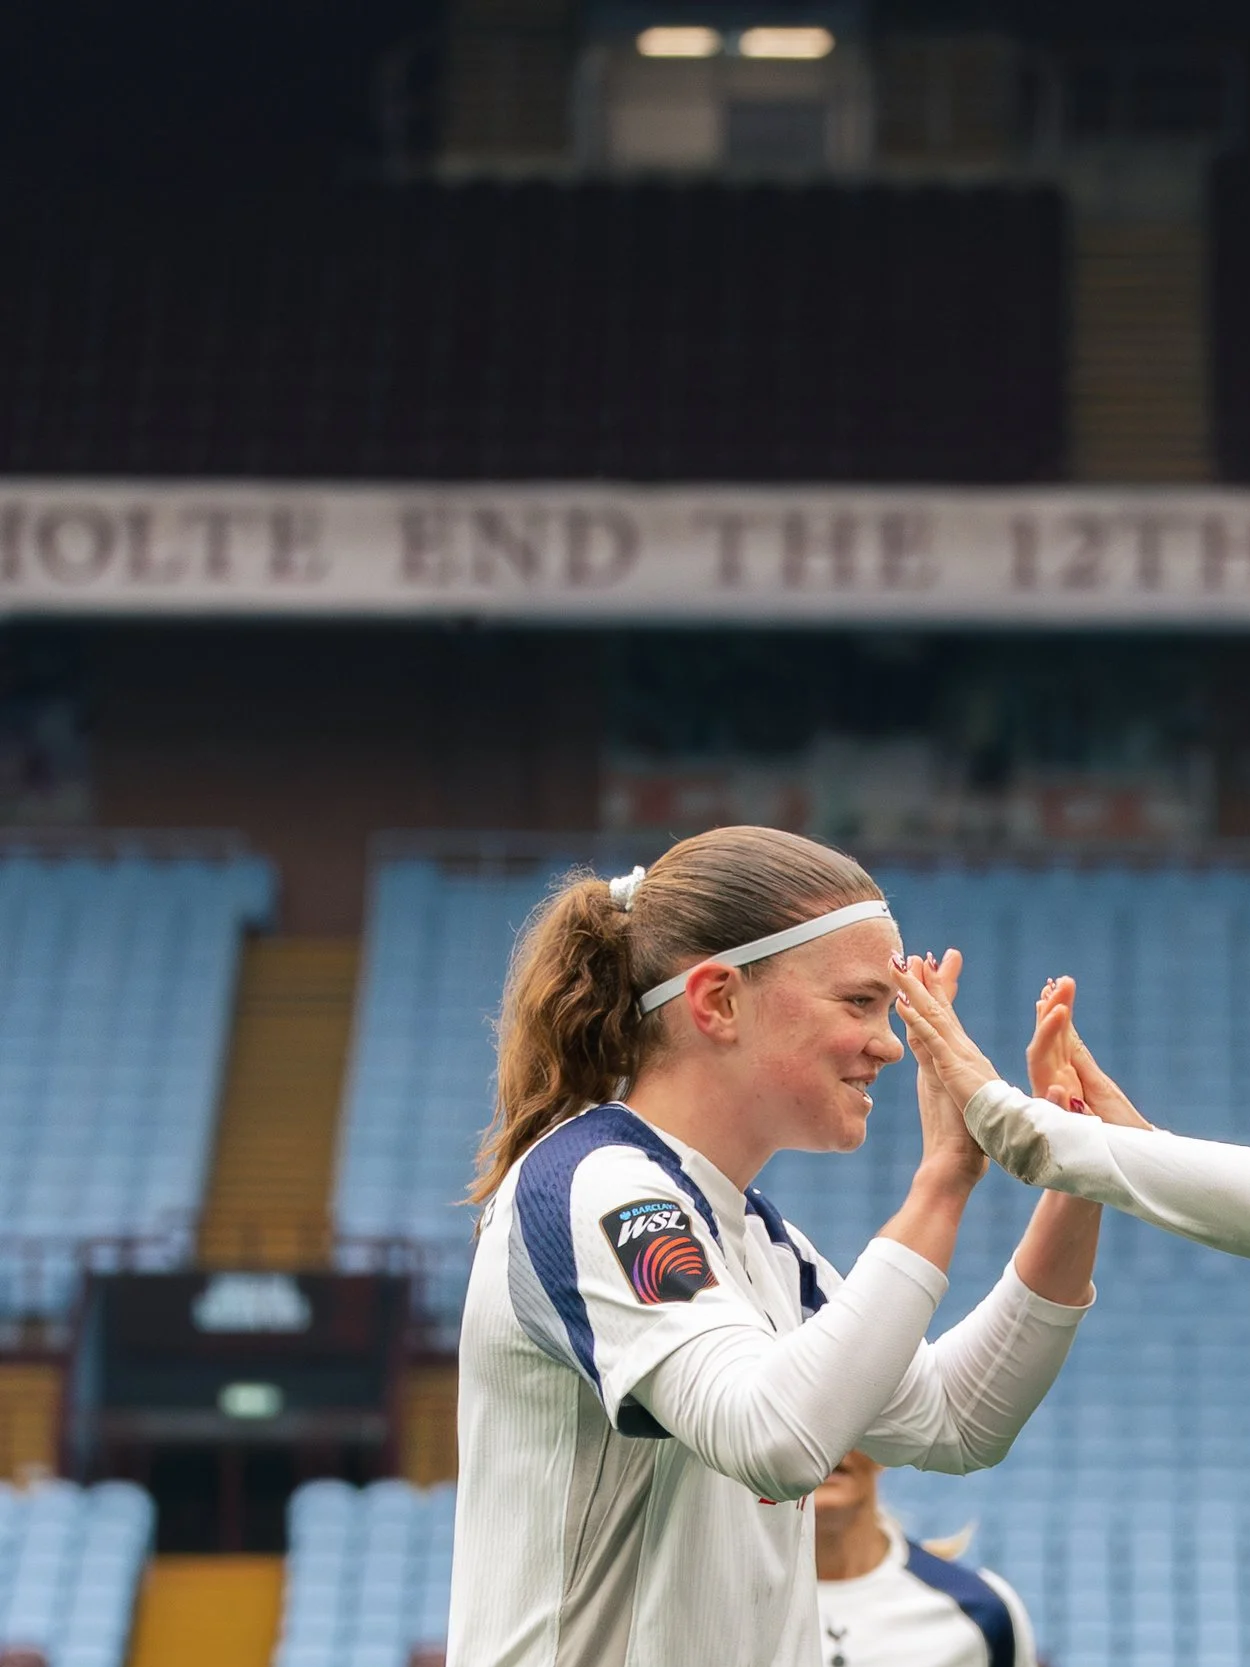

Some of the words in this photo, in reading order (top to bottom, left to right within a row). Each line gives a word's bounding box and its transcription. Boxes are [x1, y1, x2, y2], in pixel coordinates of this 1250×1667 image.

[400, 500, 645, 592] END
[692, 507, 940, 594] THE
[617, 1210, 687, 1248] WSL
